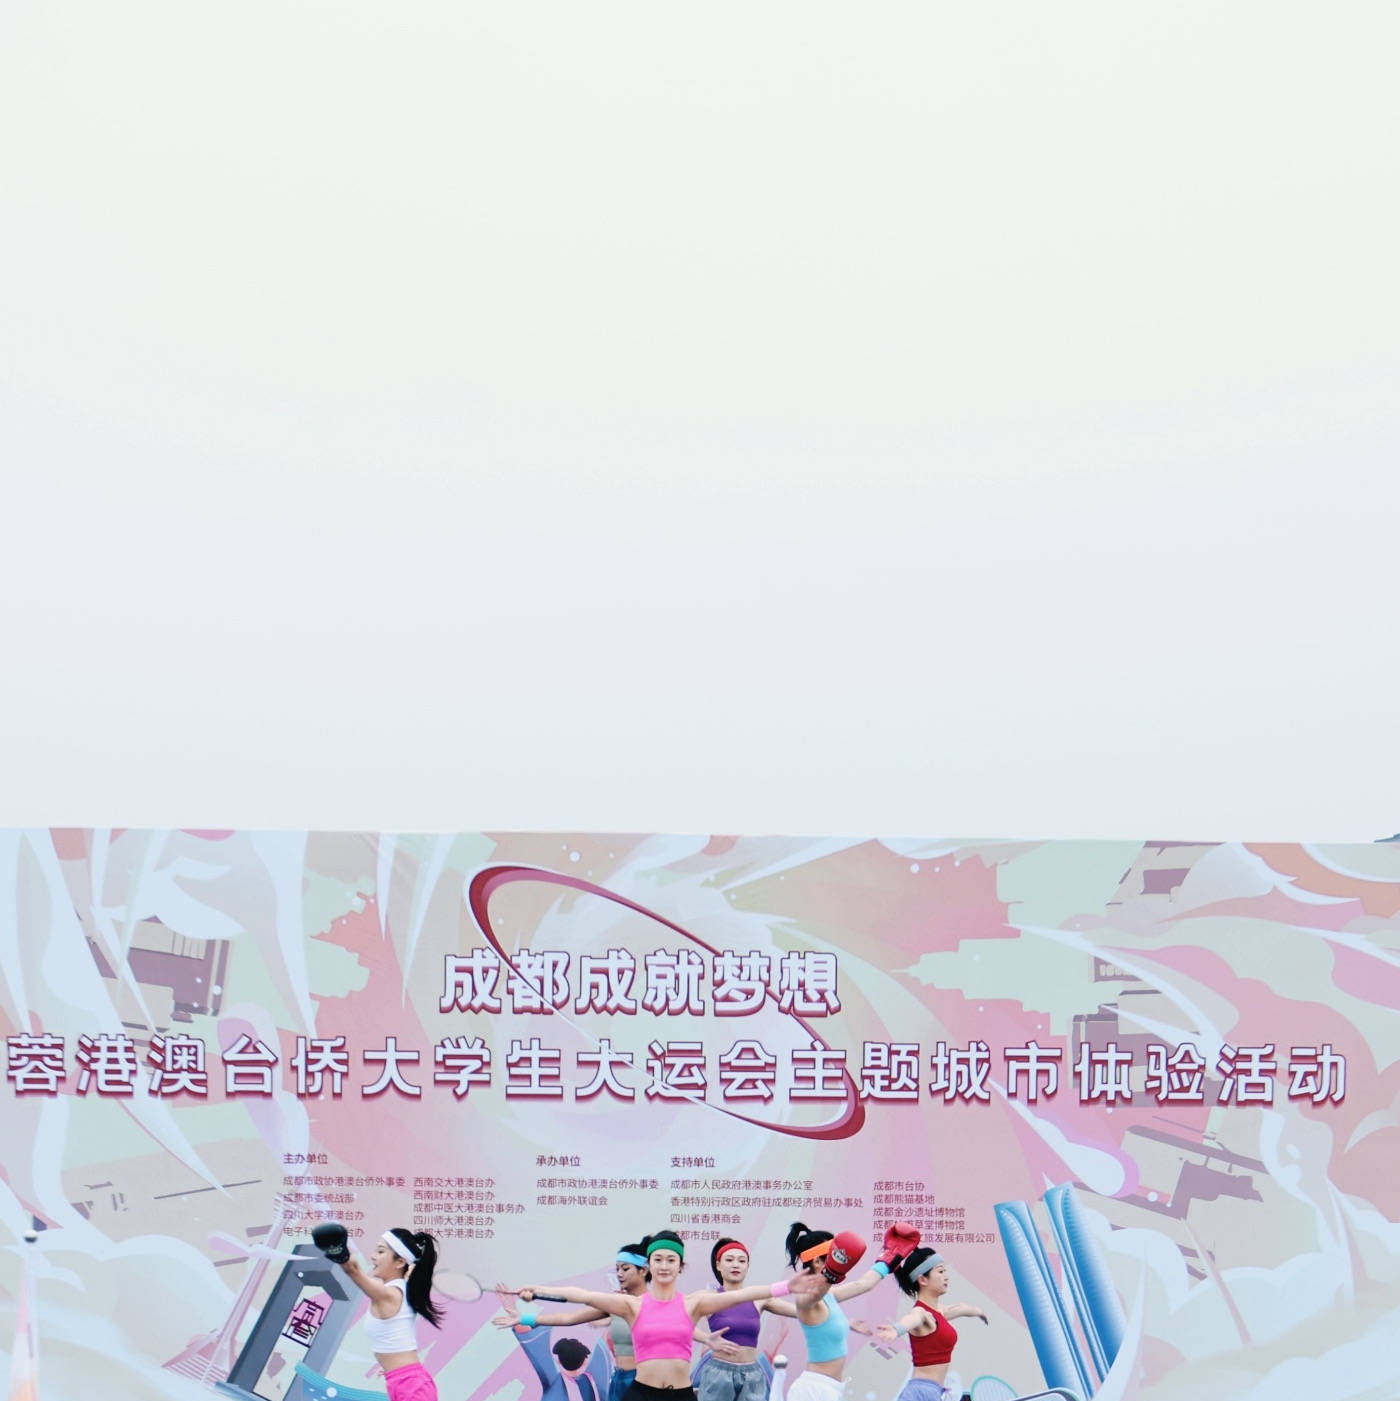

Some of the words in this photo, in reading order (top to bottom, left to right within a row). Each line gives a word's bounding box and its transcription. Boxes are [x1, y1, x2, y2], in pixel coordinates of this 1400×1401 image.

[439, 948, 841, 1017] 成都成就梦想
[283, 1152, 329, 1165] 主办单位
[536, 1155, 581, 1168] 承办单位
[670, 1156, 716, 1169] 支持单位
[283, 1175, 406, 1188] 成都市政协港澳台侨外事委
[413, 1176, 495, 1188] 西南交大港澳台办
[536, 1178, 659, 1190] 成都市政协港澳台侨外事委
[670, 1179, 814, 1191] 成都市人民政府港澳事务办公室
[873, 1180, 926, 1191] 成都市台协
[413, 1190, 495, 1201] 西南财大港澳台办
[536, 1195, 609, 1206] 成都海外联谊会
[873, 1194, 935, 1205] 成都熊猫基地
[670, 1196, 864, 1208] 香港特别行政区政府驻成都经济贸易办事处
[413, 1203, 526, 1214] 成都中医大港澳台事务办
[873, 1207, 965, 1217] 成都金沙遗址博物馆
[413, 1215, 495, 1226] 四川师大港澳台办
[670, 1213, 742, 1224] 四川省香港商会
[675, 1230, 721, 1240] 都市台联
